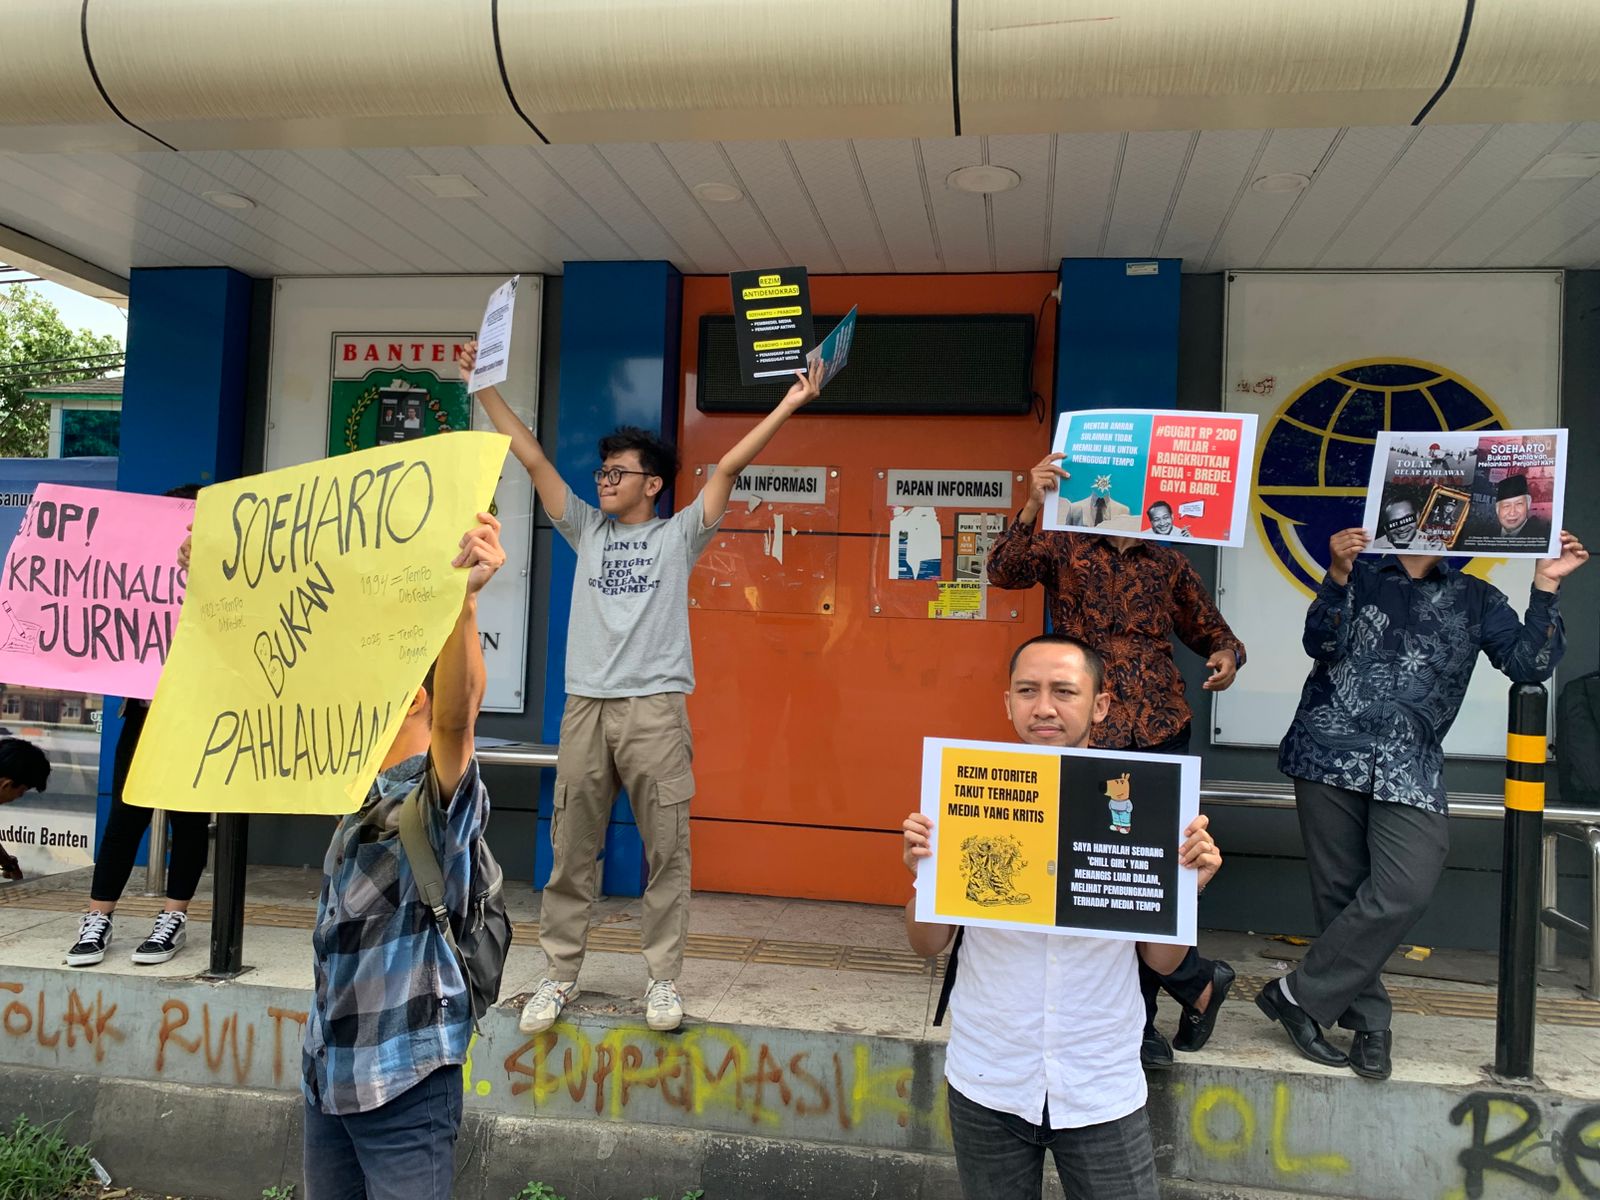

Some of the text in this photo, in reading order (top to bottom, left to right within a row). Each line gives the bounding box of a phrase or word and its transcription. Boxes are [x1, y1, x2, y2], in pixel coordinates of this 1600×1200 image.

[760, 276, 780, 285] REZIM
[744, 286, 799, 298] ANTIDEMOKRASI
[1156, 425, 1237, 441] #GUGAT RP 200
[1173, 439, 1209, 453] MILIAR
[1490, 443, 1546, 454] SOEHARTO
[1112, 457, 1135, 467] TEMPO
[1156, 452, 1230, 469] BANGKRUTKAN
[1397, 459, 1433, 468] TOLAK
[1151, 465, 1184, 479] MEDIA
[1194, 468, 1232, 483] BREDEL
[755, 476, 817, 493] INFORMASI
[896, 480, 1003, 497] PAPAN INFORMASI
[1160, 480, 1220, 496] GAYA BARU.
[222, 461, 433, 589] SOEHARTO
[633, 541, 648, 550] US
[614, 557, 653, 569] FIGHT
[605, 575, 648, 587] CLEAN
[608, 568, 632, 578] FOR
[253, 560, 335, 699] BUKAN
[957, 765, 1038, 784] REZIM OTORITER
[954, 784, 1039, 803] TAKUT TERHADAP
[947, 803, 1045, 823] MEDIA YANG KRITIS
[40, 827, 88, 848] Banten
[1073, 841, 1164, 858] SAYA HANYALAH SEORANG
[1087, 856, 1149, 871] 'CHILL GIRL' YANG
[1074, 868, 1161, 886] MENANGIS LUAR DALAM,
[1070, 882, 1164, 899] MELIHAT PEMBUNGKAMAN
[1073, 896, 1161, 912] TERHADAP MEDIA TEMPO
